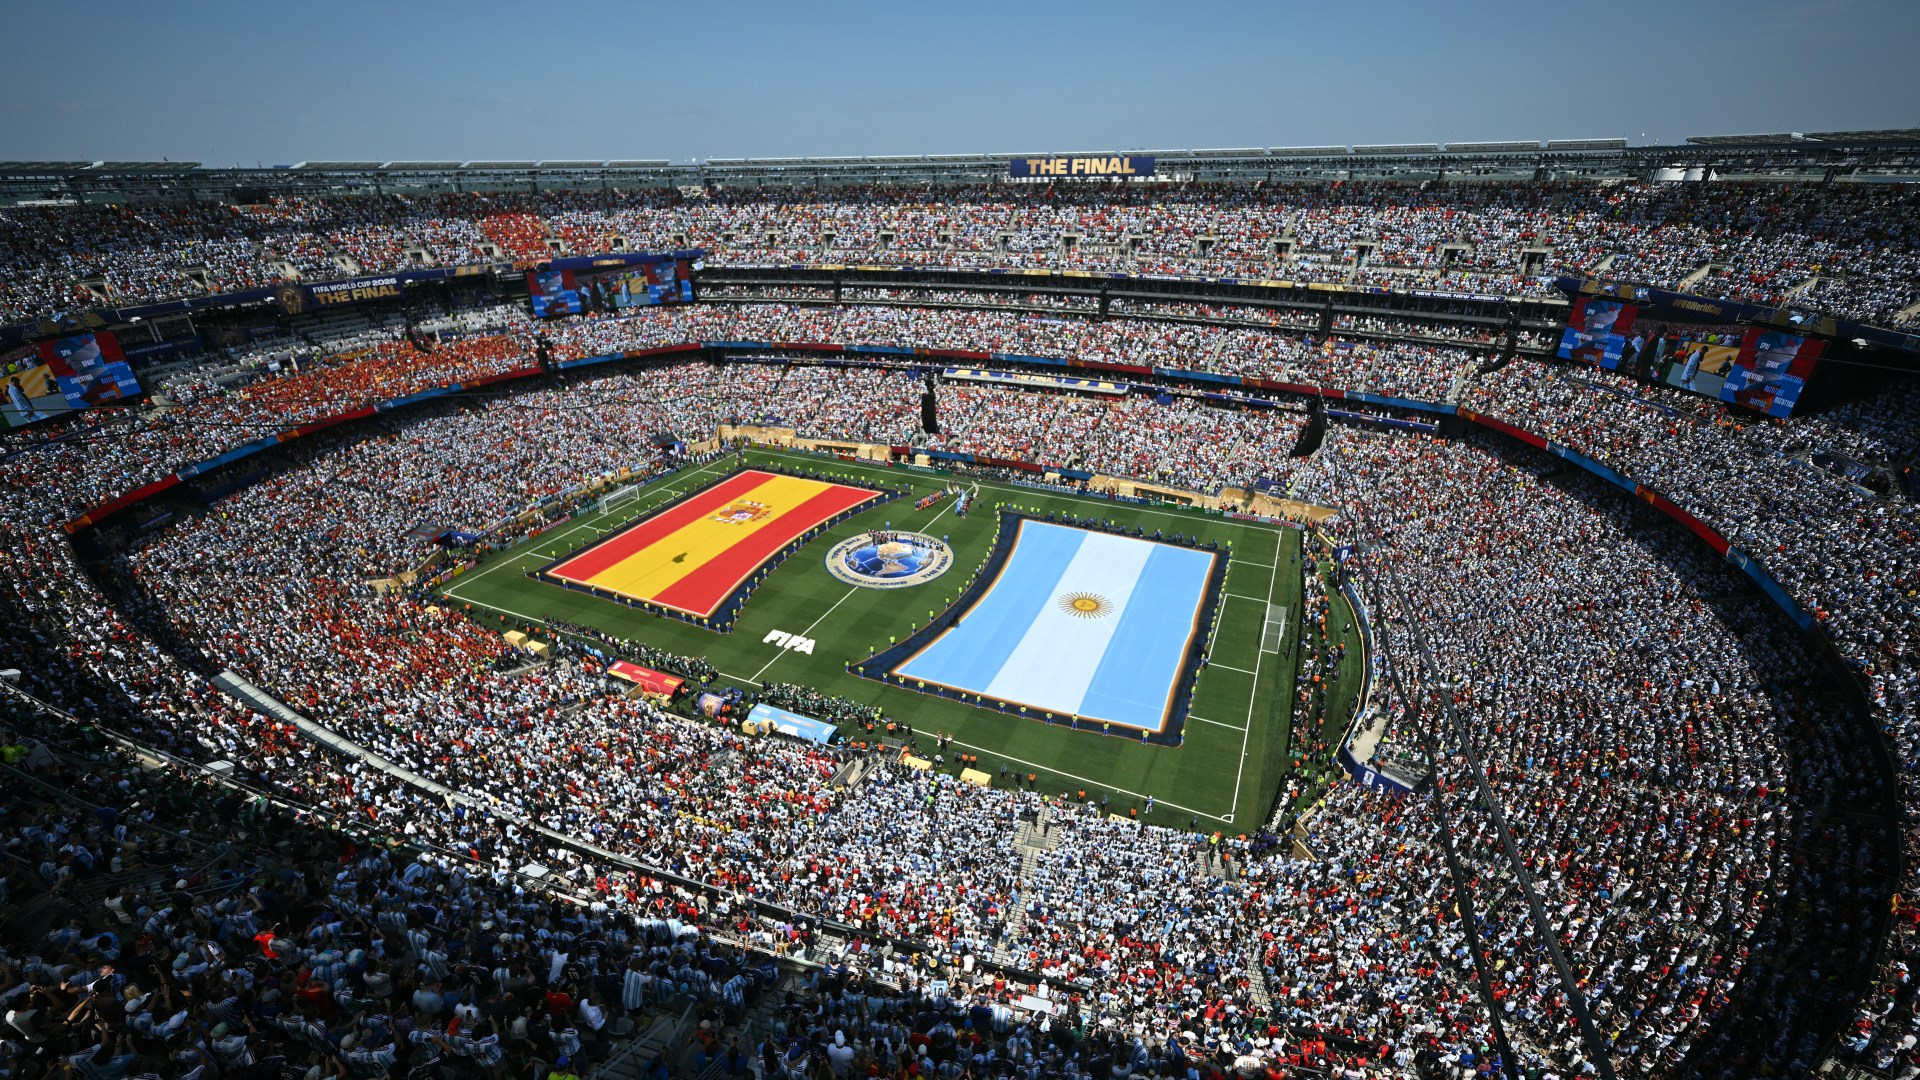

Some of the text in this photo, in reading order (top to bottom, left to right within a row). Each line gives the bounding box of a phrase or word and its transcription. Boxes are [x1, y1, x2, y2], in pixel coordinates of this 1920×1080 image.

[1026, 157, 1136, 175] THE FINAL
[312, 277, 397, 294] FIFA WORLD CUP 2026
[315, 285, 400, 305] THE FINAL
[1672, 299, 1723, 315] #FIFAWorldCup
[1012, 373, 1057, 383] THE FINAL
[907, 464, 936, 474] Hisense
[1039, 483, 1068, 492] AMERICA
[1115, 495, 1139, 504] ULTRA
[1232, 513, 1258, 522] verizon
[1269, 518, 1296, 529] verizon
[921, 569, 939, 579] THE
[762, 629, 816, 656] FIFA
[934, 987, 943, 998] 10
